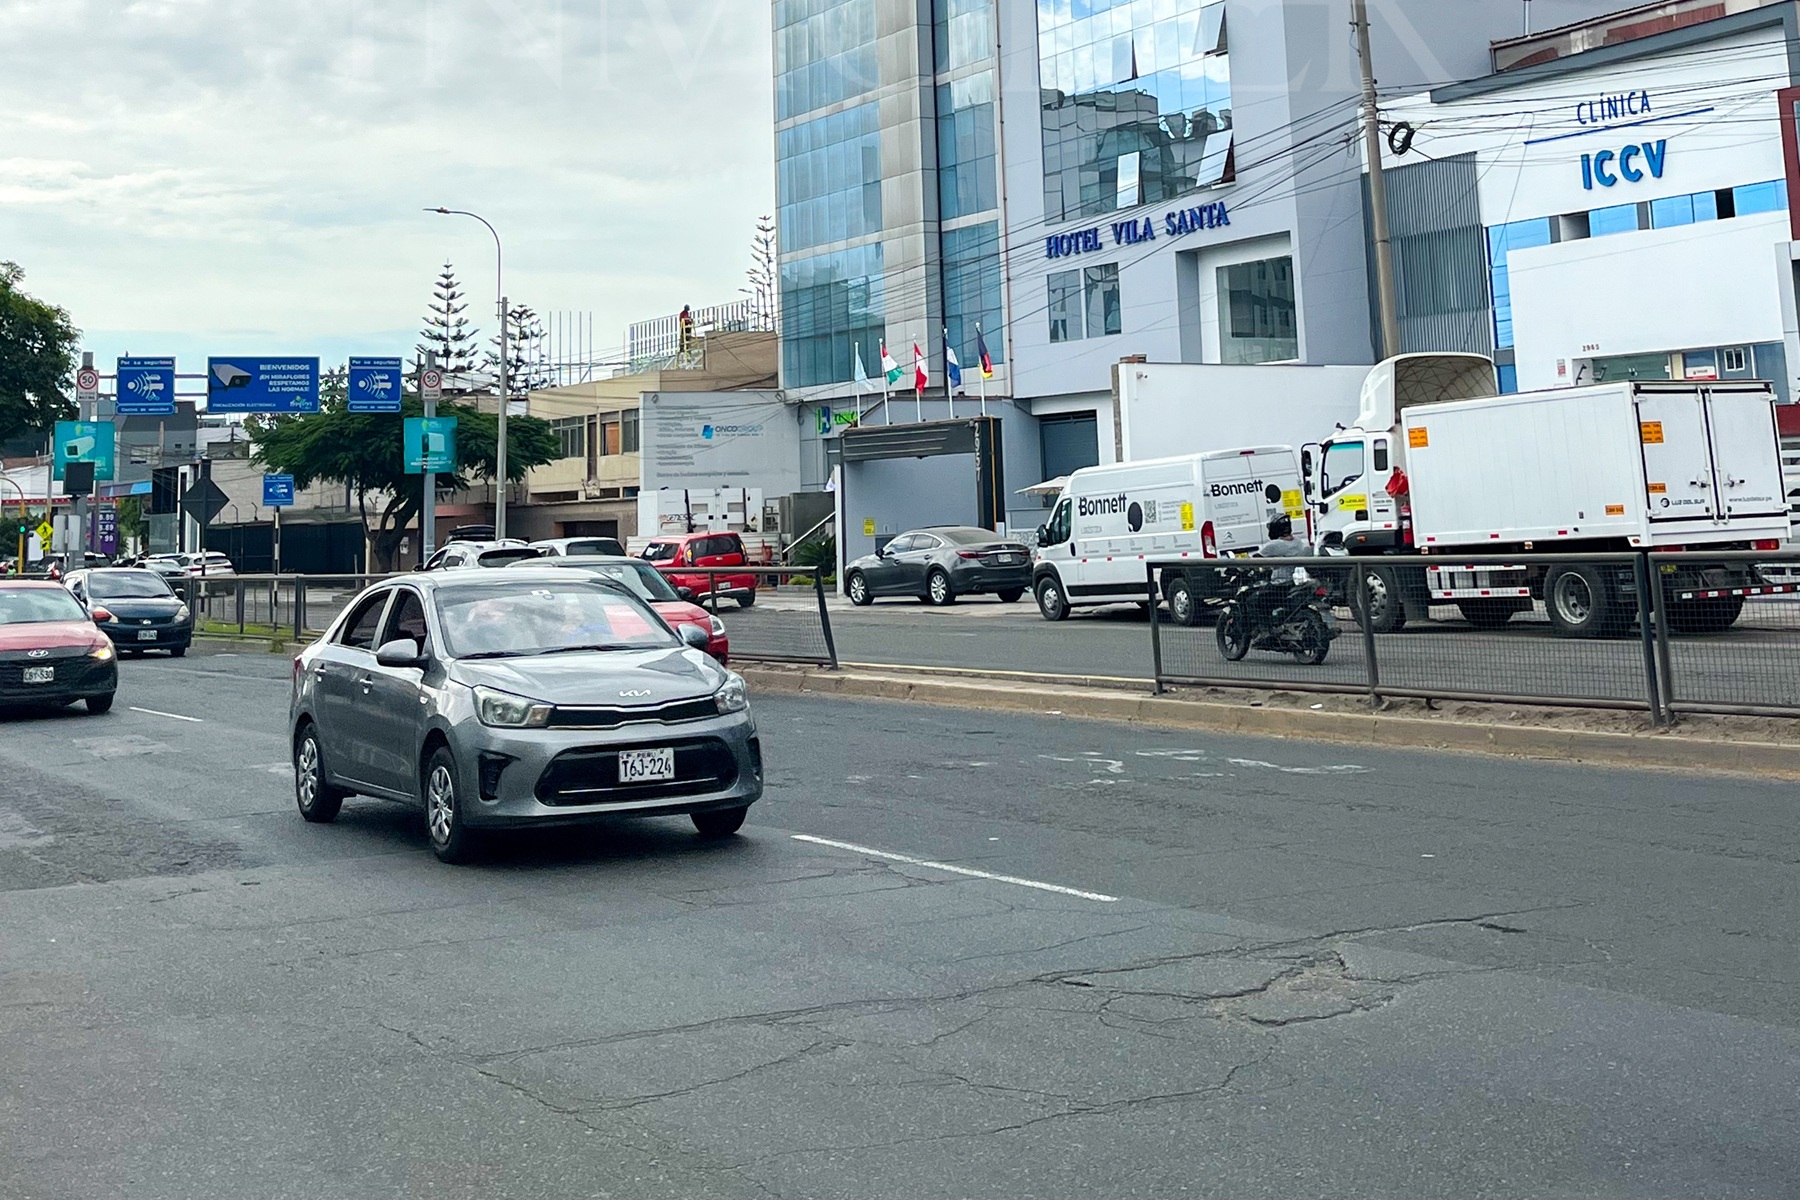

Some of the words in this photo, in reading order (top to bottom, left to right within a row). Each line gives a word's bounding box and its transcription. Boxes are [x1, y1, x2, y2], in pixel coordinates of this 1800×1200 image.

[1577, 90, 1652, 125] CLÍNICA
[1580, 139, 1668, 190] ICCV
[1045, 227, 1103, 259] HOTEL
[1111, 216, 1156, 246] VILA
[1165, 200, 1231, 236] SANTA
[82, 375, 94, 384] 50
[426, 374, 437, 382] 50
[1210, 479, 1263, 497] Bonnett
[1078, 492, 1127, 517] Bonnett
[619, 689, 651, 697] KIA
[621, 757, 672, 778] T6J-224
